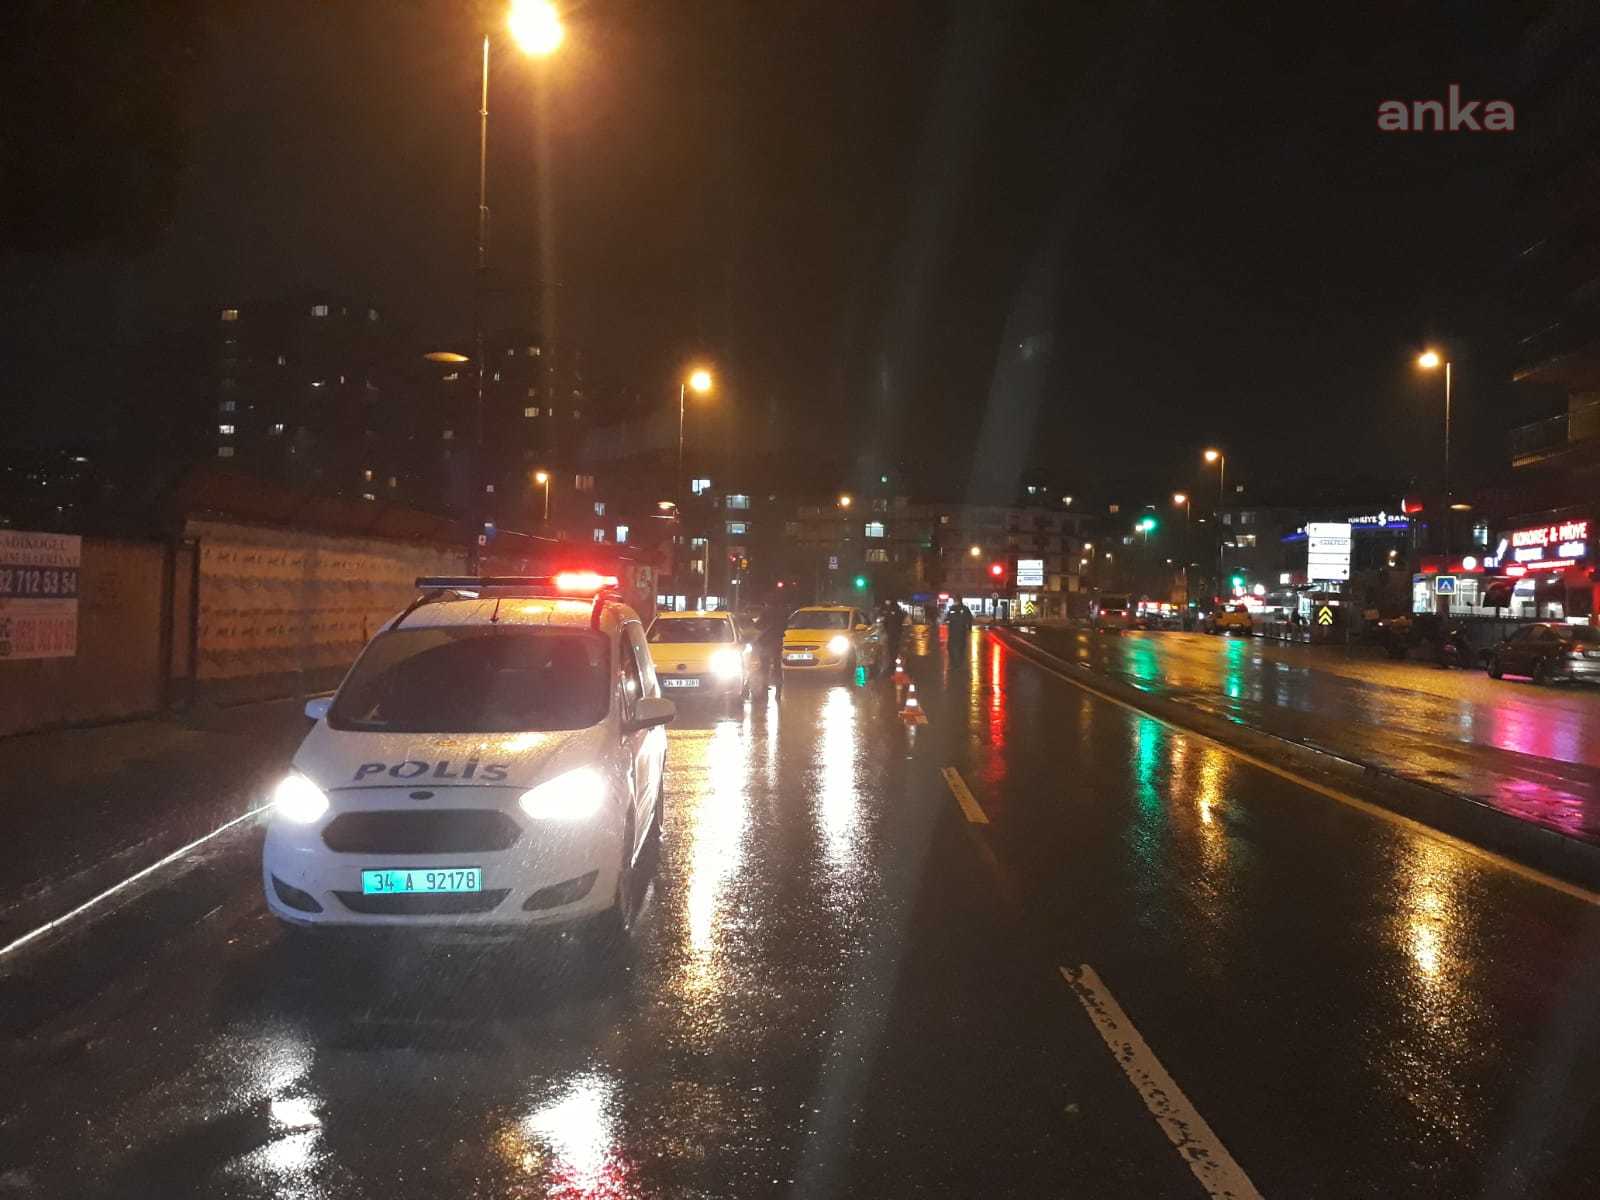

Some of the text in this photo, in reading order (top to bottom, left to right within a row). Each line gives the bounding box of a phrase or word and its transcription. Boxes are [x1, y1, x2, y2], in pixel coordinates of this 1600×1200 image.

[353, 757, 511, 781] POLİS
[374, 871, 476, 892] 34 A 92178
